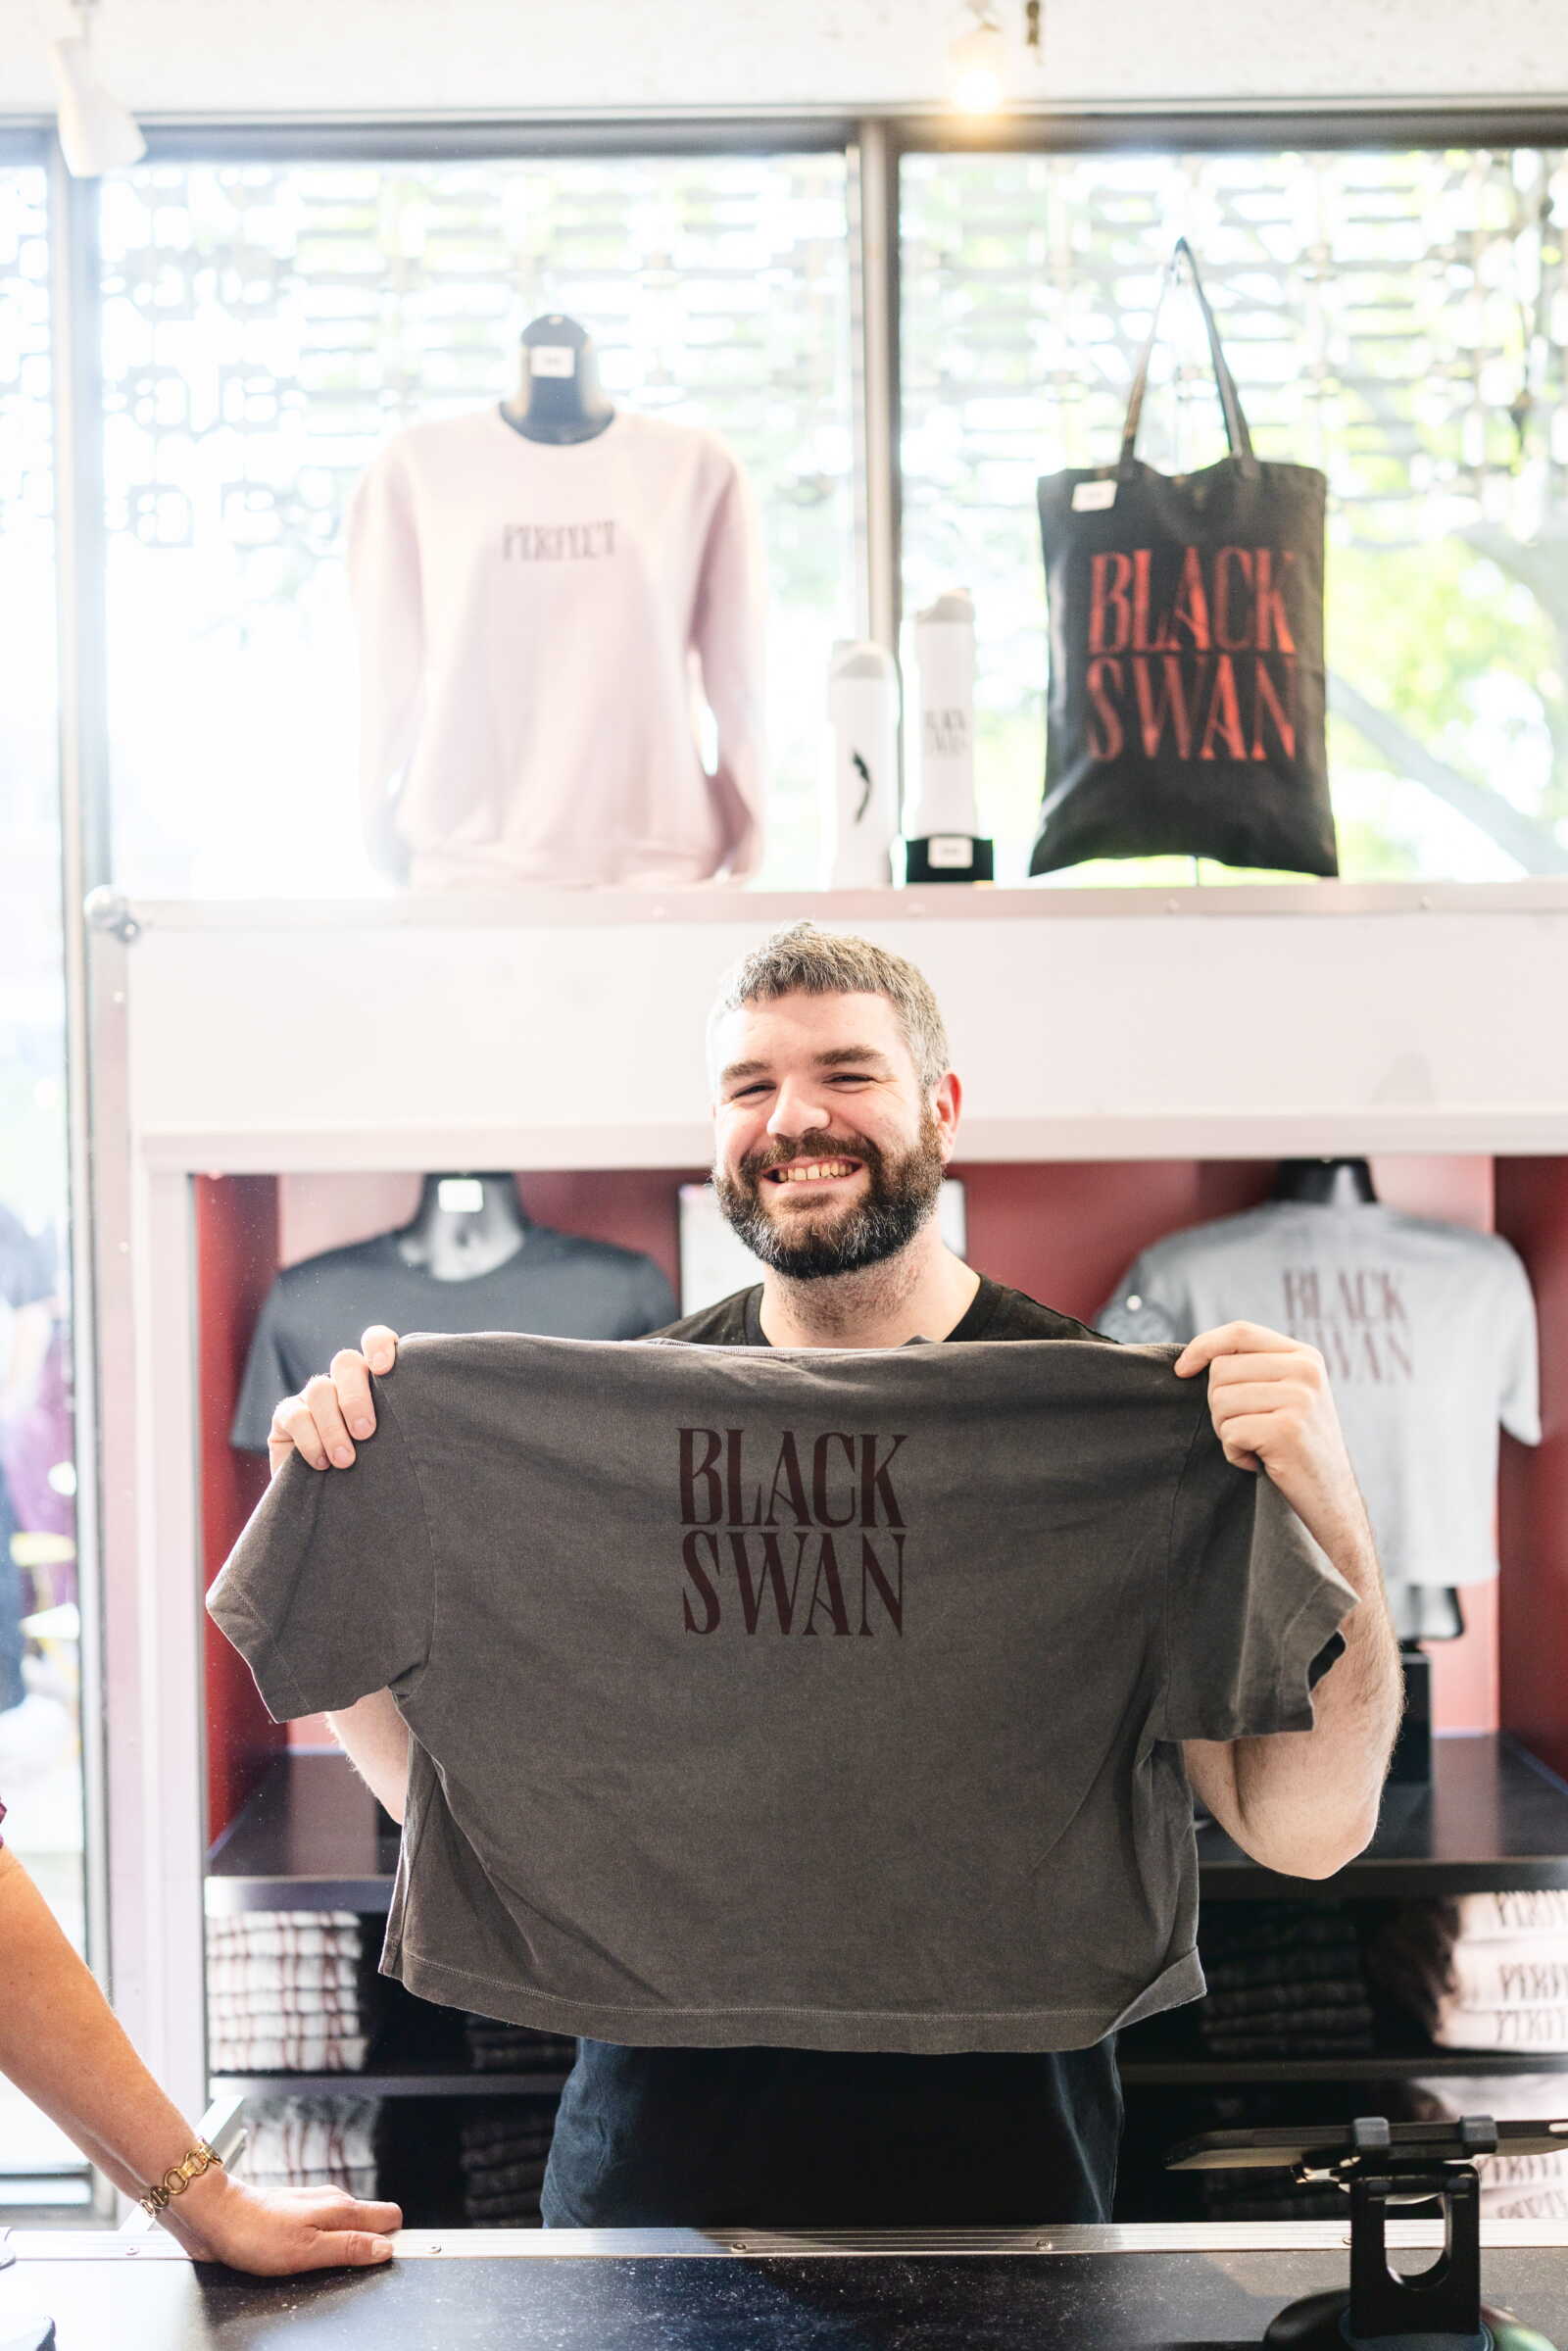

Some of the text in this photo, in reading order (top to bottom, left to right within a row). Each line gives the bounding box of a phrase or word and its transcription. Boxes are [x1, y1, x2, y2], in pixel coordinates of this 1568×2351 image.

[1087, 546, 1298, 655] BLACK
[1086, 653, 1299, 760] SWAN
[1282, 1267, 1408, 1322] BLACK
[1288, 1324, 1413, 1381] WAN
[677, 1428, 908, 1528] BLACK
[682, 1530, 906, 1638] SWAN
